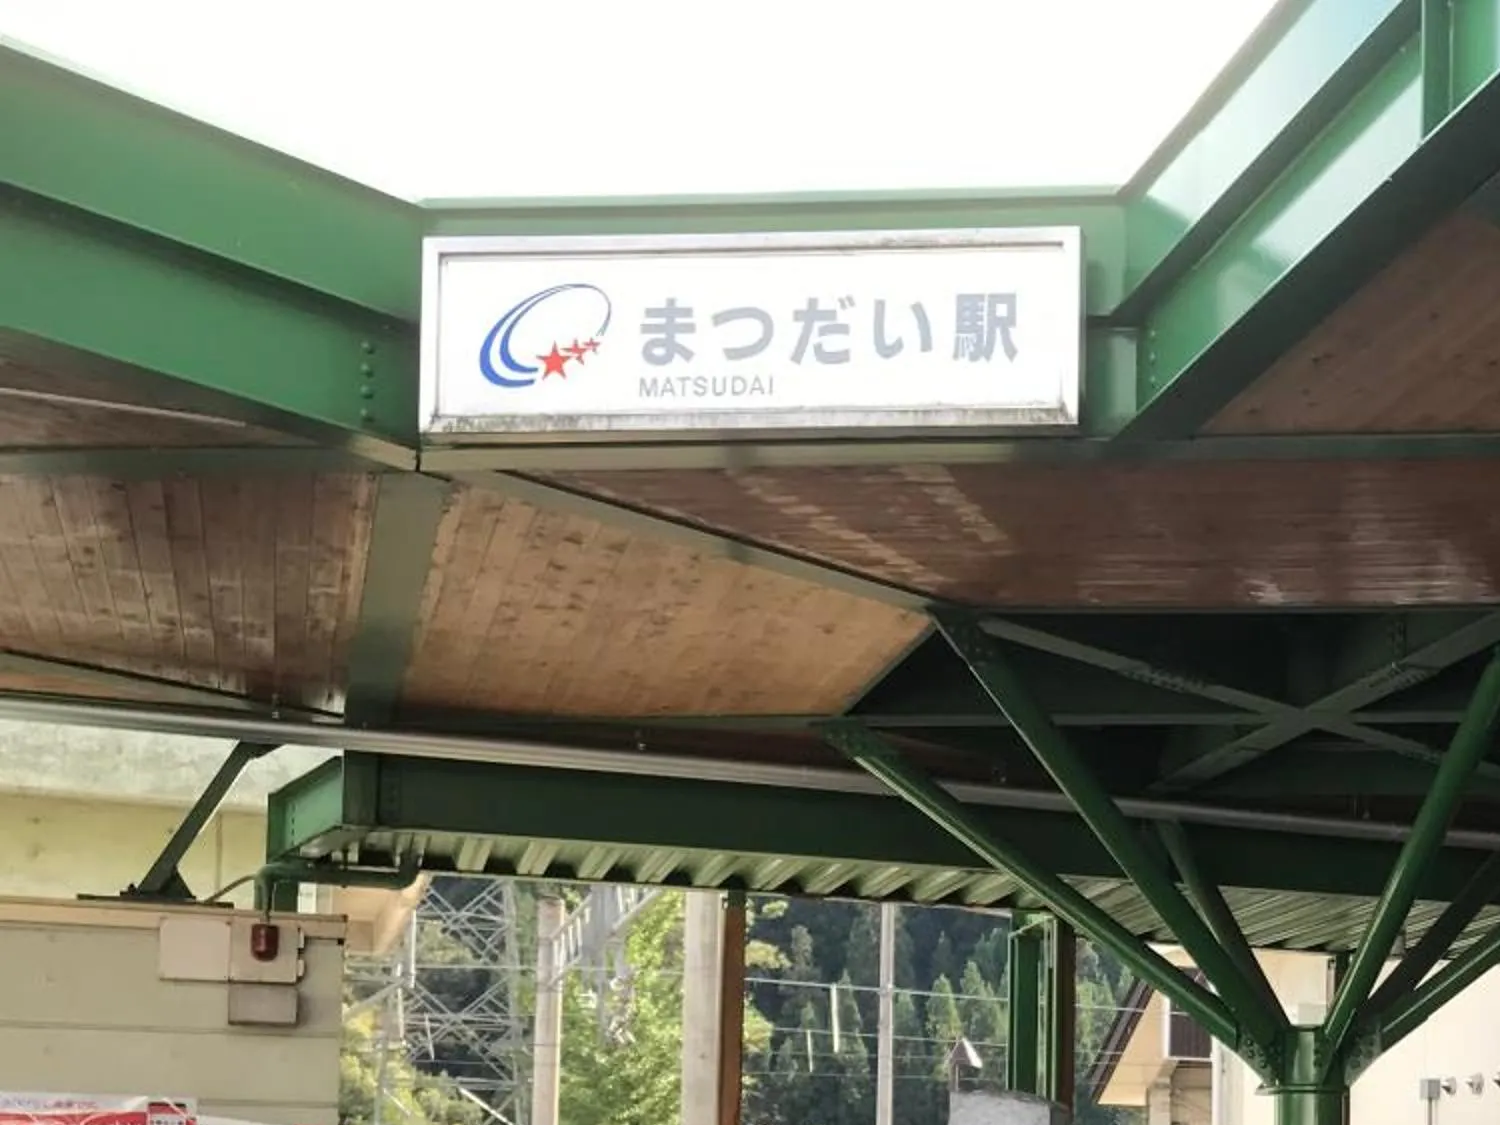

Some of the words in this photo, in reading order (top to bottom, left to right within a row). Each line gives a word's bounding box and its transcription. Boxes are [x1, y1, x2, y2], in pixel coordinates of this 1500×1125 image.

[639, 293, 1018, 366] まつだい駅
[639, 376, 774, 398] MATSUDAI
